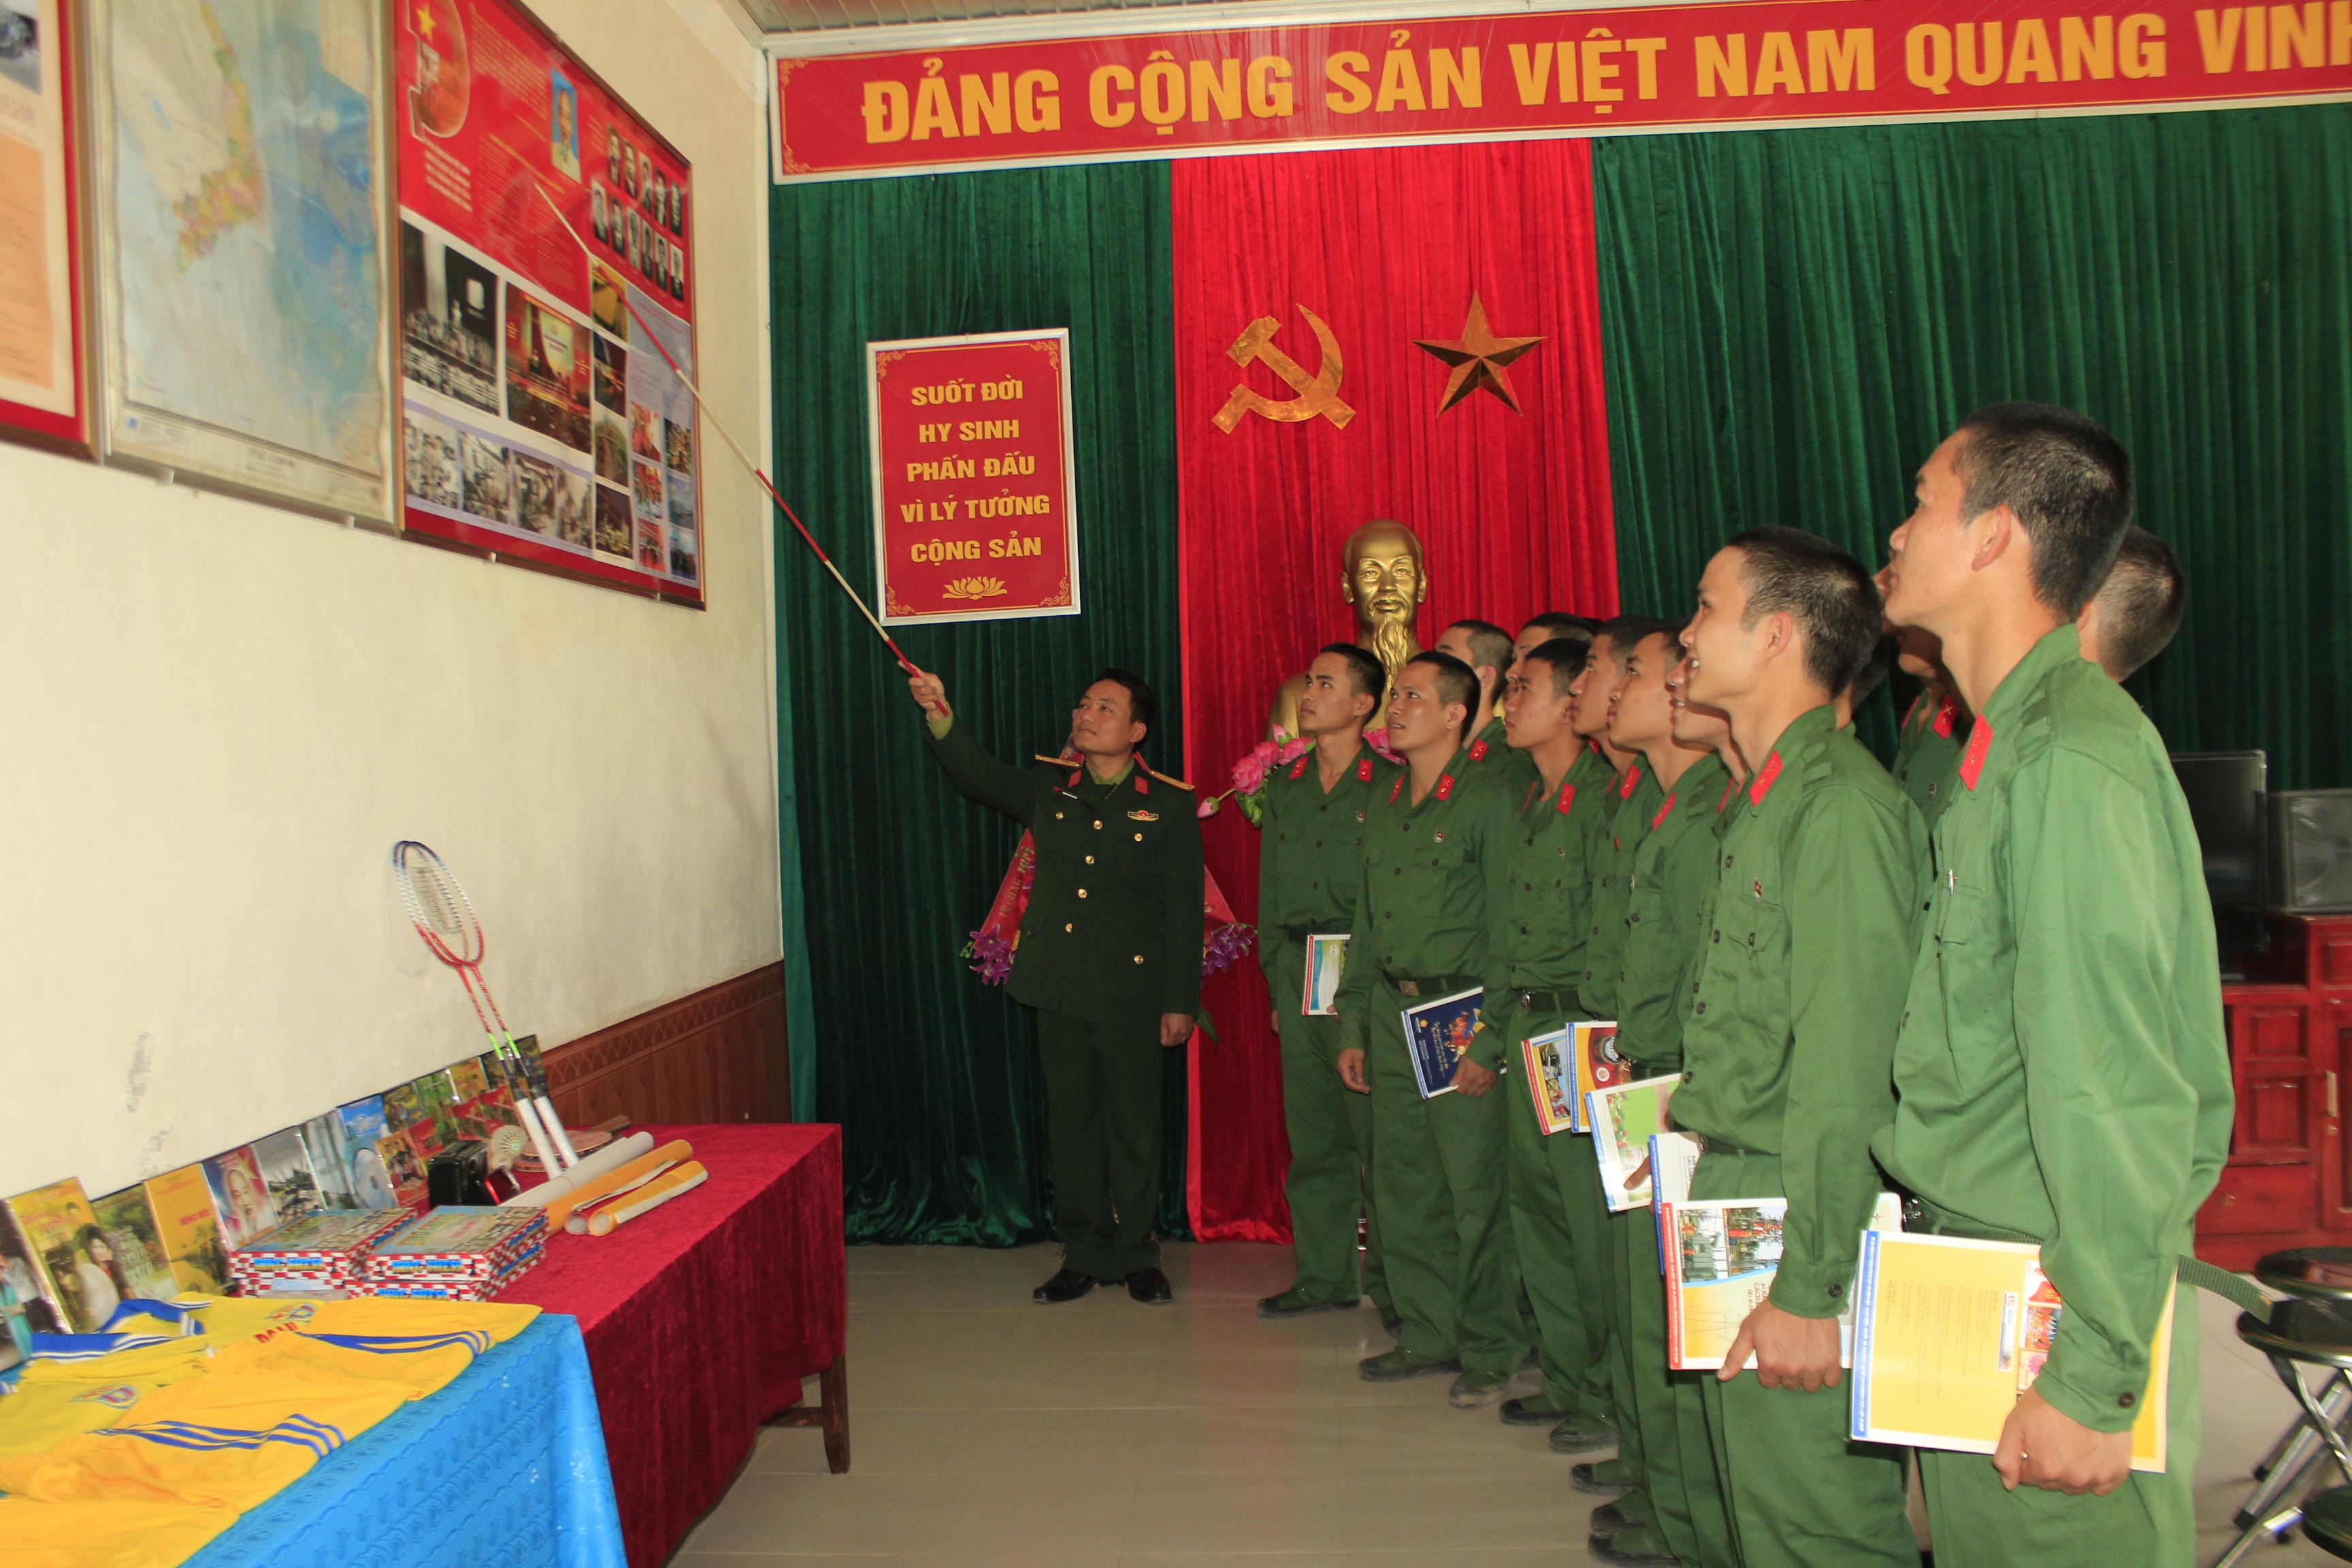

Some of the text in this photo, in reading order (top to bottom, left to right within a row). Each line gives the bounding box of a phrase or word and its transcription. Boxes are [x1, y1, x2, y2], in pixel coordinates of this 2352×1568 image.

[862, 57, 1061, 144] ĐẢNG
[1089, 50, 1294, 135] CỘNG
[1324, 29, 1483, 114] SẢN
[1508, 28, 1667, 114] VIỆT
[1694, 27, 1876, 97] NAM
[1906, 14, 2166, 95] QUANG
[911, 374, 1024, 406] SUỐT ĐỜI
[919, 419, 1019, 443] HY SINH
[906, 451, 1035, 482] PHẤN ĐẤU
[900, 489, 1051, 523] VÌ LÝ TƯỞNG
[911, 530, 1042, 566] CỘNG SẢN
